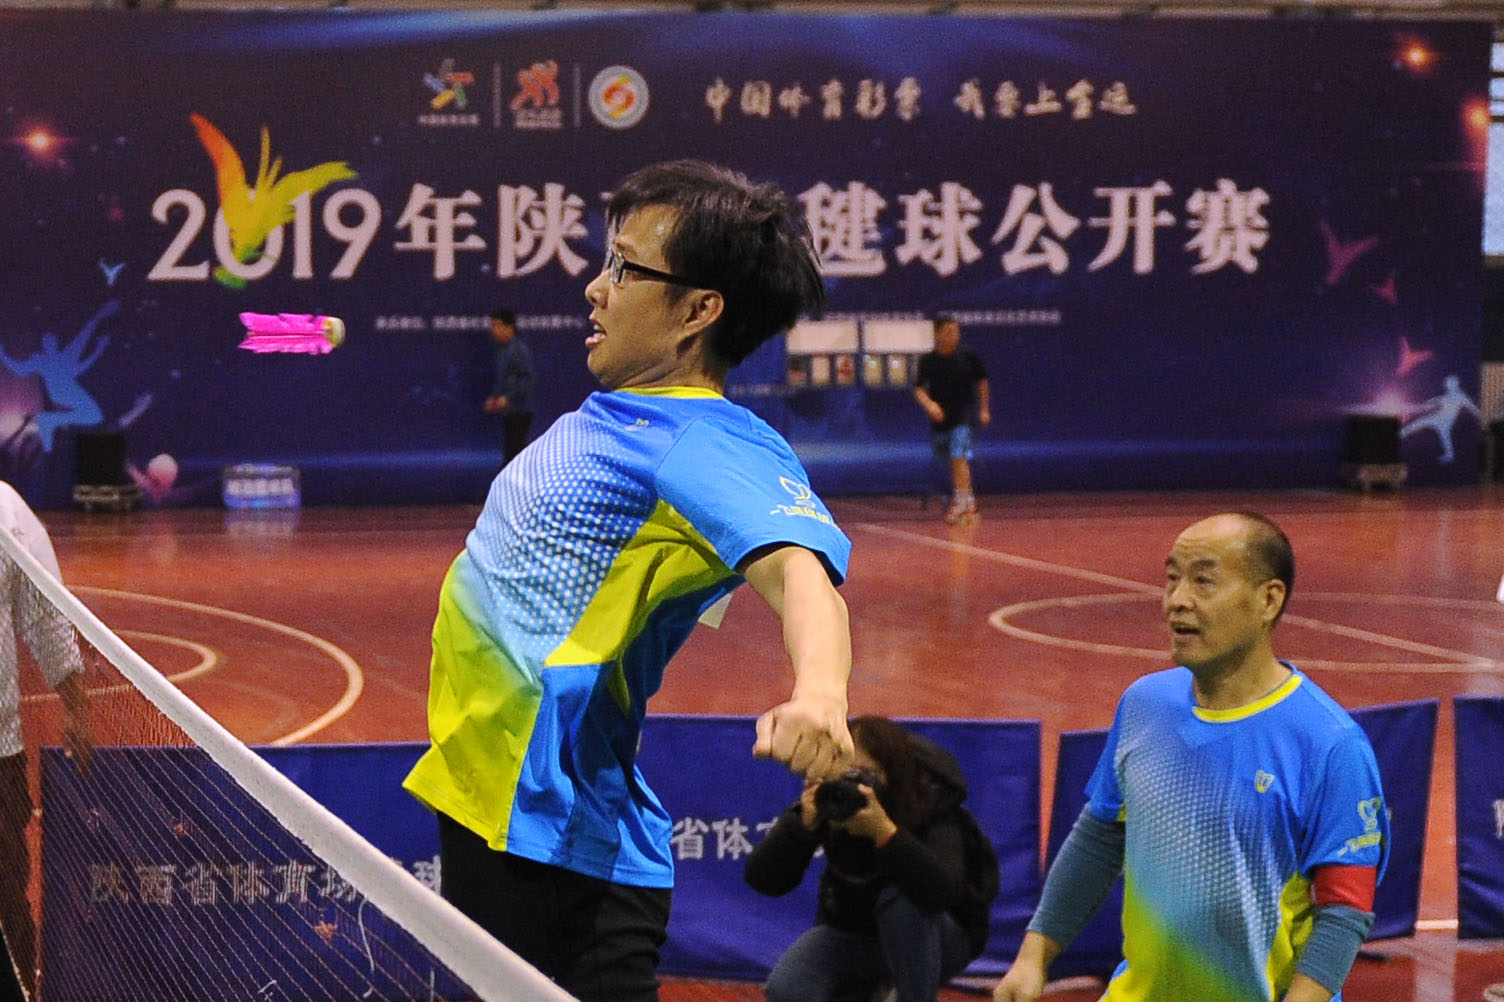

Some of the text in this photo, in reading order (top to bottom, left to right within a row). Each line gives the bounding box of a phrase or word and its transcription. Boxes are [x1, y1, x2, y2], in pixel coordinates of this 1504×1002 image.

[146, 178, 1271, 281] 2019年陕毽球公开赛
